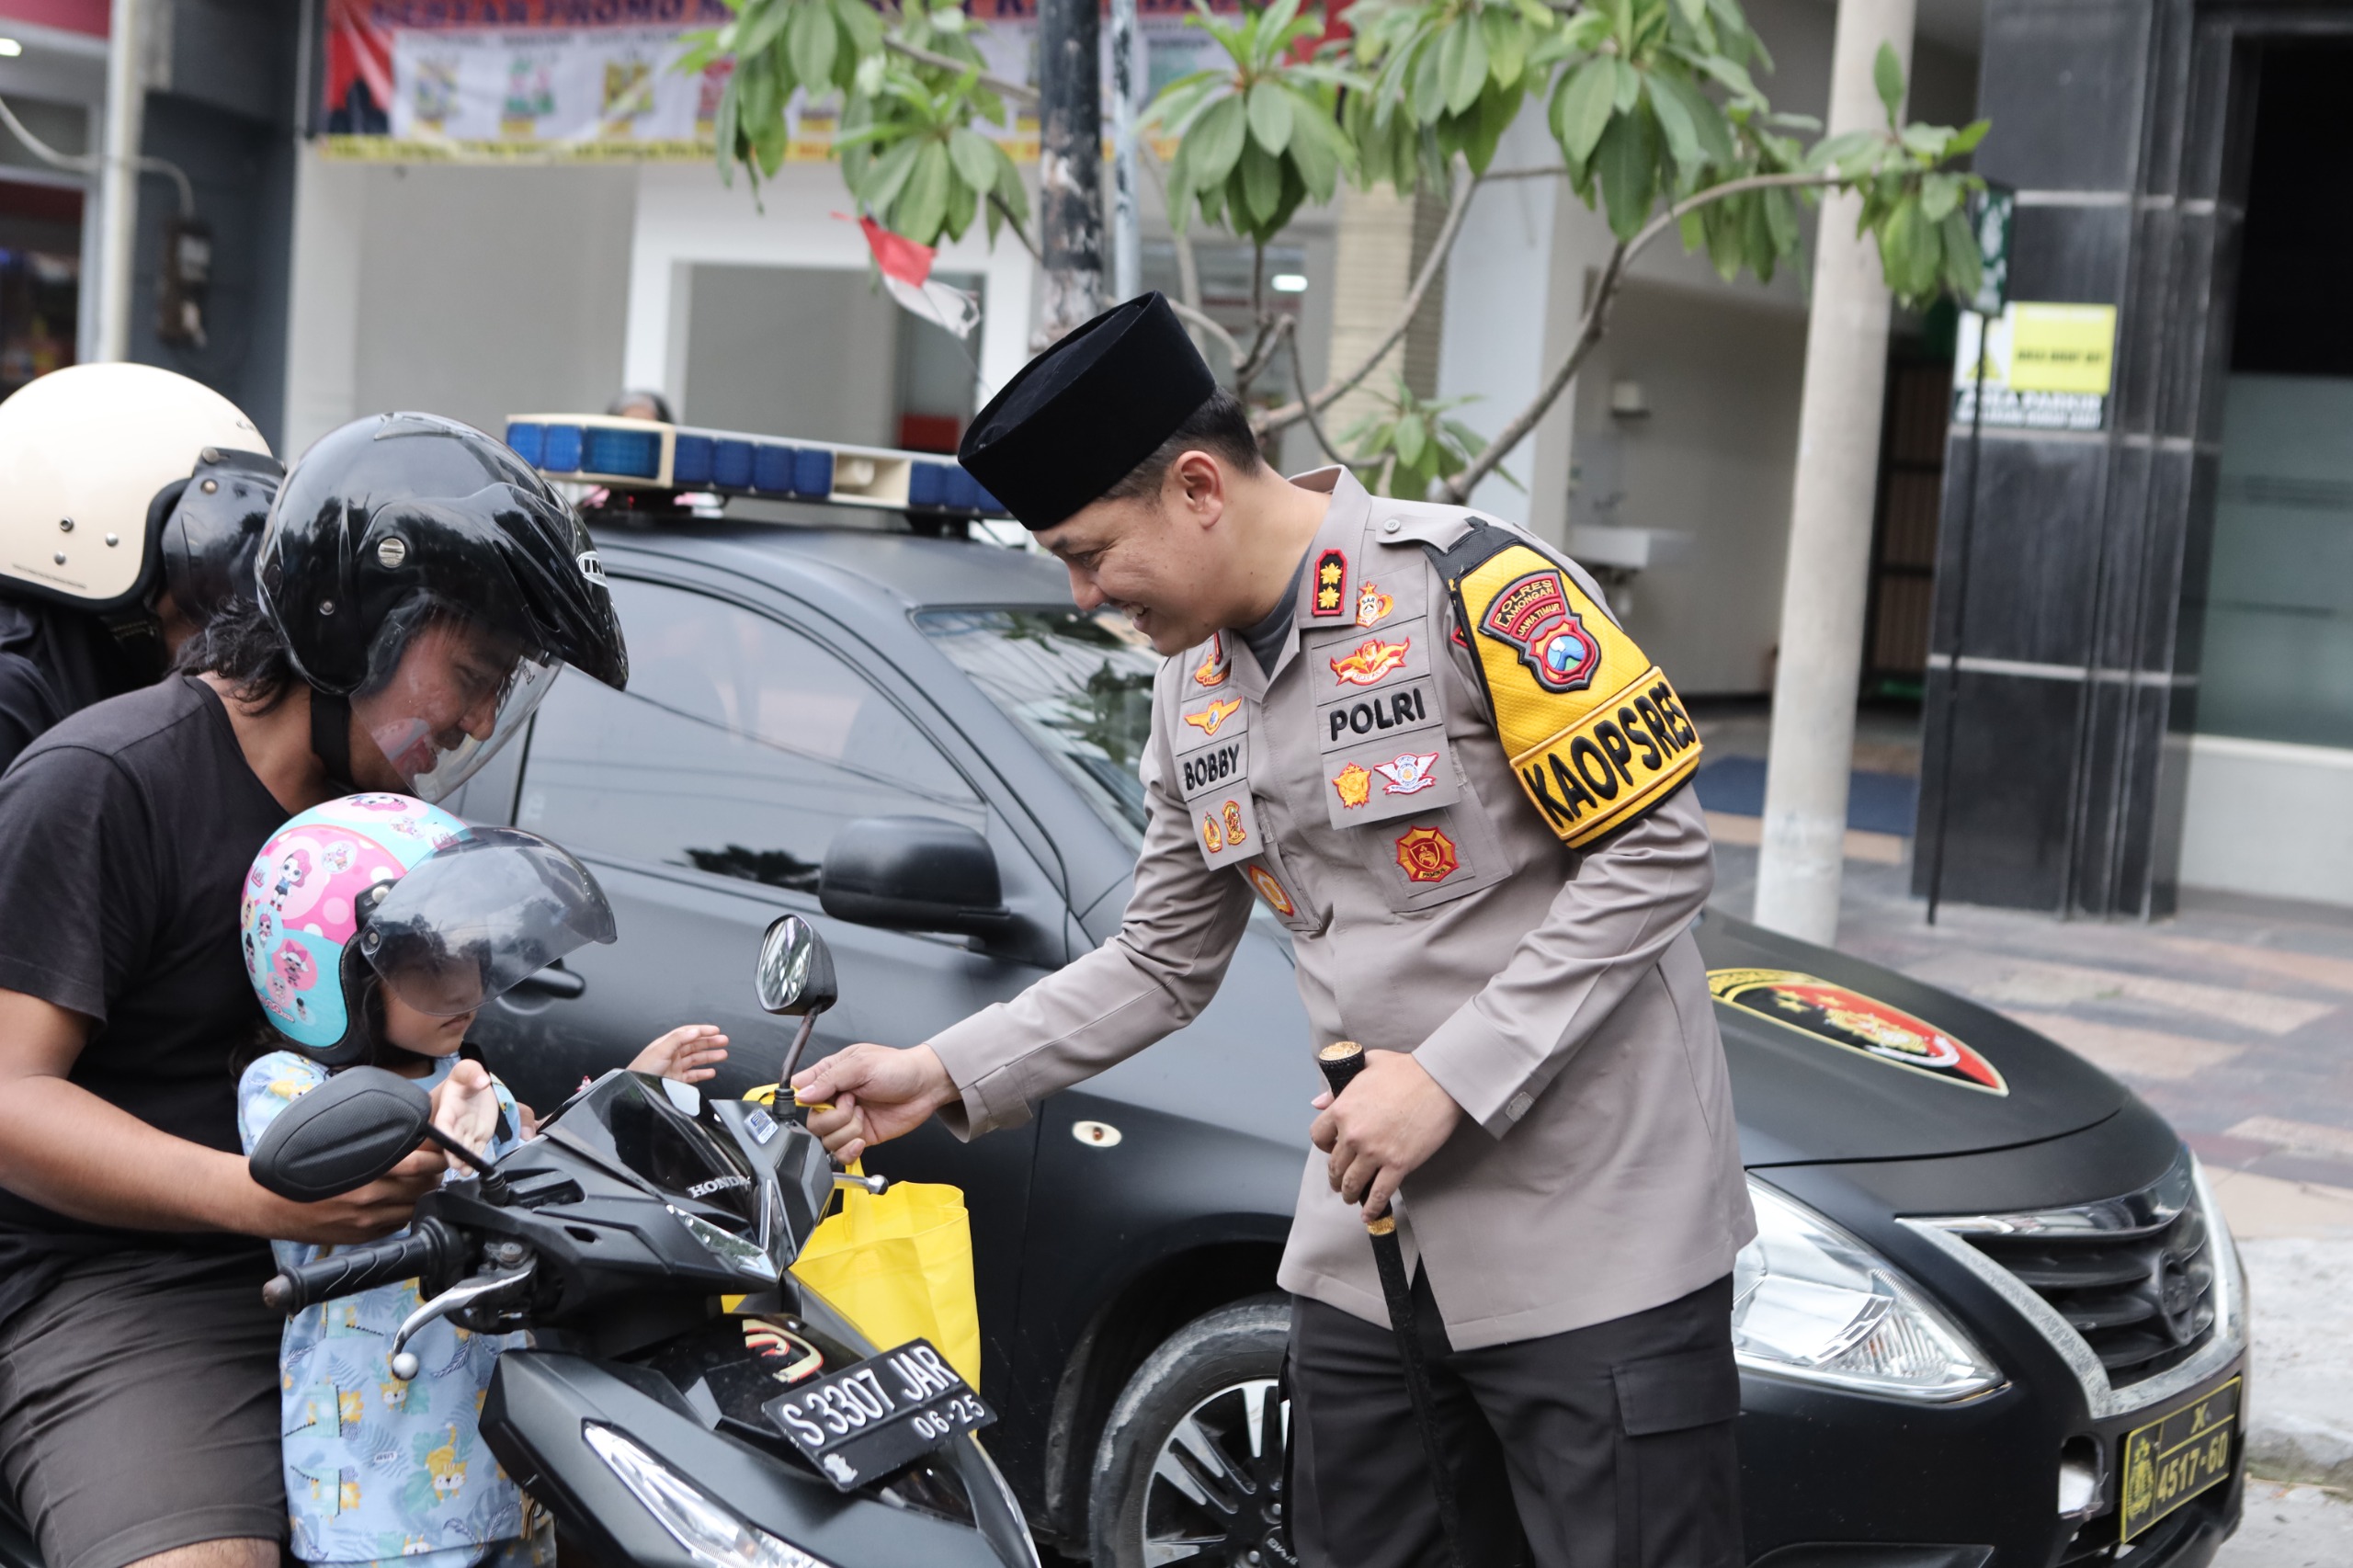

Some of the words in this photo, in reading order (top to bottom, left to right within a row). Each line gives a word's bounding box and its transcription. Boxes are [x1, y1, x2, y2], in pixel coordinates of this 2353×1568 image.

[1494, 580, 1553, 626] POLRES
[1500, 587, 1554, 628] LAMONGAN
[1518, 615, 1539, 636] JAWA
[1534, 603, 1561, 617] TIMUR
[1329, 688, 1426, 741] POLRI
[1183, 744, 1240, 791] BOBBY
[1522, 681, 1697, 829] KAOPSRES
[686, 1176, 751, 1199] HONDA
[782, 1403, 824, 1447] S
[806, 1369, 895, 1435] 3307
[890, 1346, 960, 1402] JAR
[2157, 1430, 2229, 1503] 4517-60
